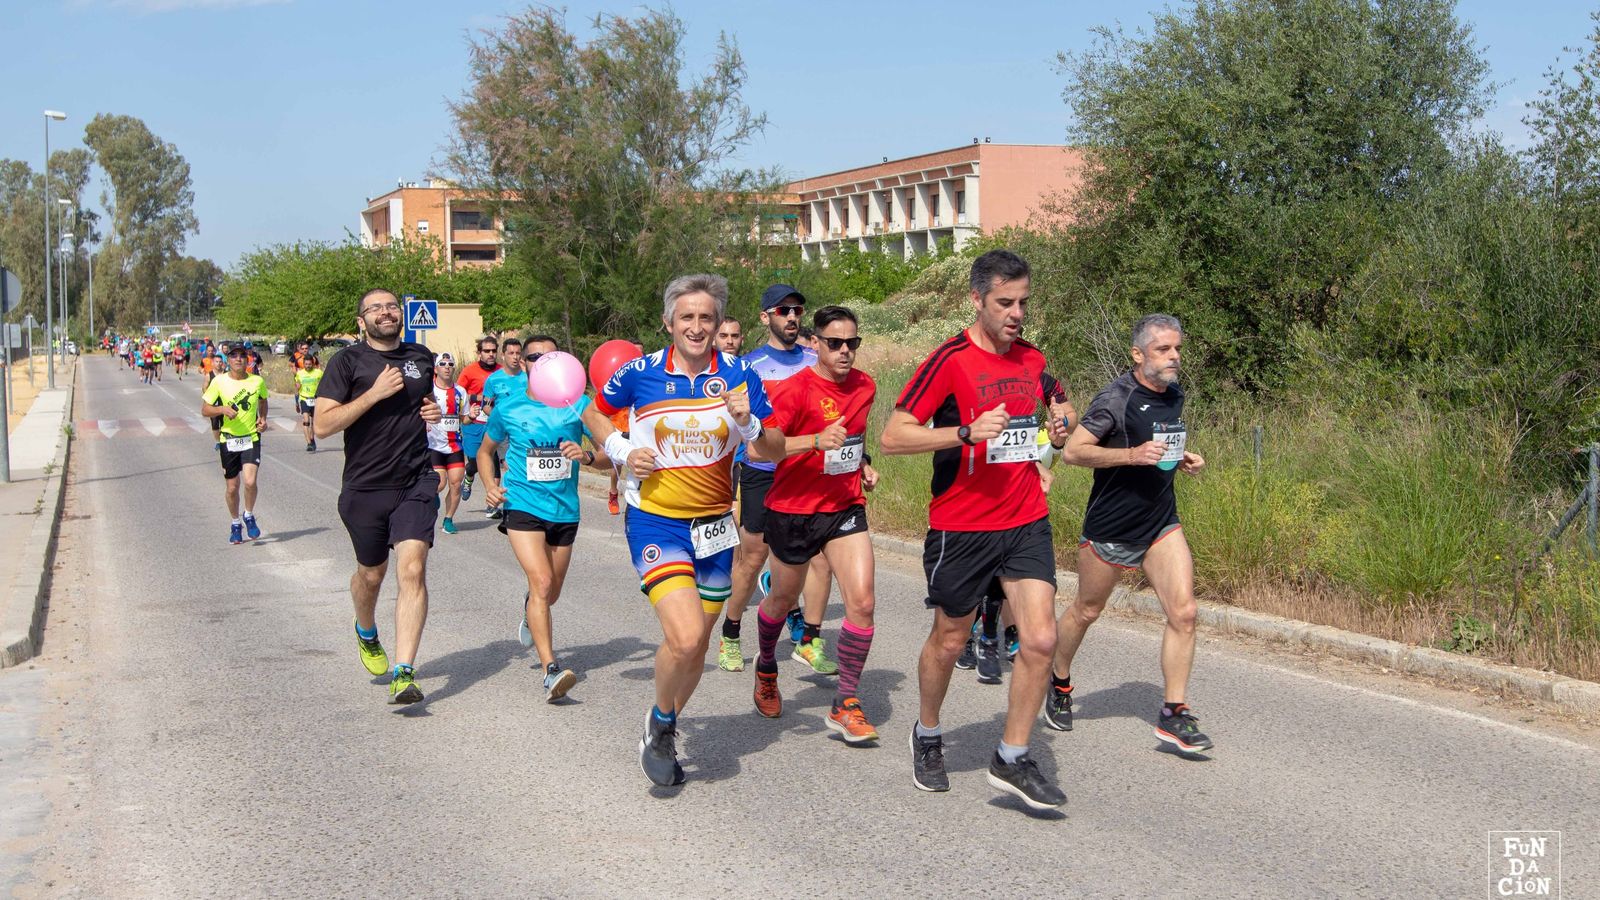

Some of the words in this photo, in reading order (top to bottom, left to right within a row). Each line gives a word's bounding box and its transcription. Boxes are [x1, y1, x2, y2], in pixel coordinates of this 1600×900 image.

[232, 388, 247, 401] MURO
[1002, 430, 1028, 446] 219
[1164, 433, 1181, 447] 449
[671, 445, 714, 459] VIENTO
[840, 447, 854, 460] 66
[538, 458, 562, 470] 803
[704, 520, 727, 540] 666
